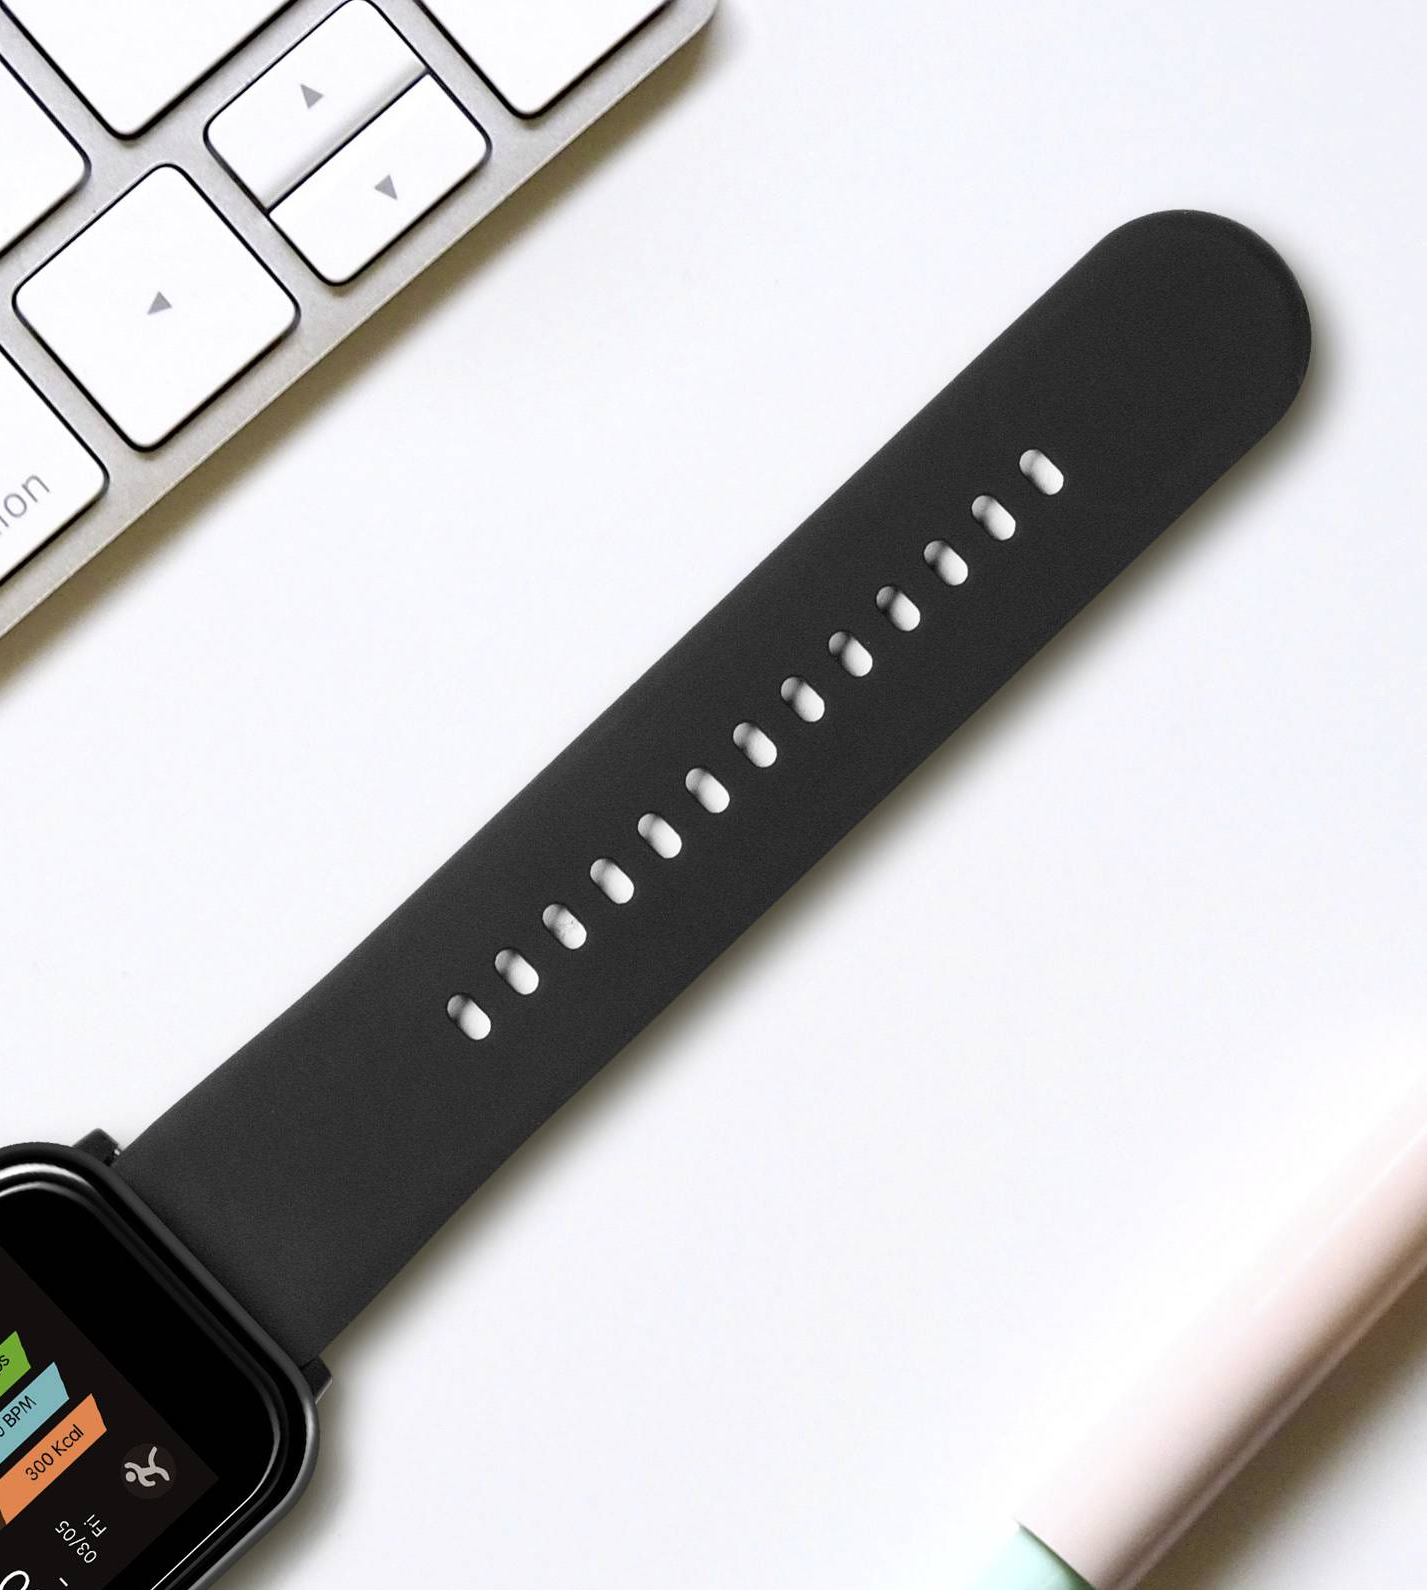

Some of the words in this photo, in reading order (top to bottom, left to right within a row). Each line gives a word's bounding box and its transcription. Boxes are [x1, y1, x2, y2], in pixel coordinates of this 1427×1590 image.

[2, 1395, 37, 1428] BPM
[25, 1452, 54, 1481] 300
[51, 1423, 85, 1457] Kcal
[54, 1520, 97, 1564] 03/05
[83, 1514, 107, 1538] Fri
